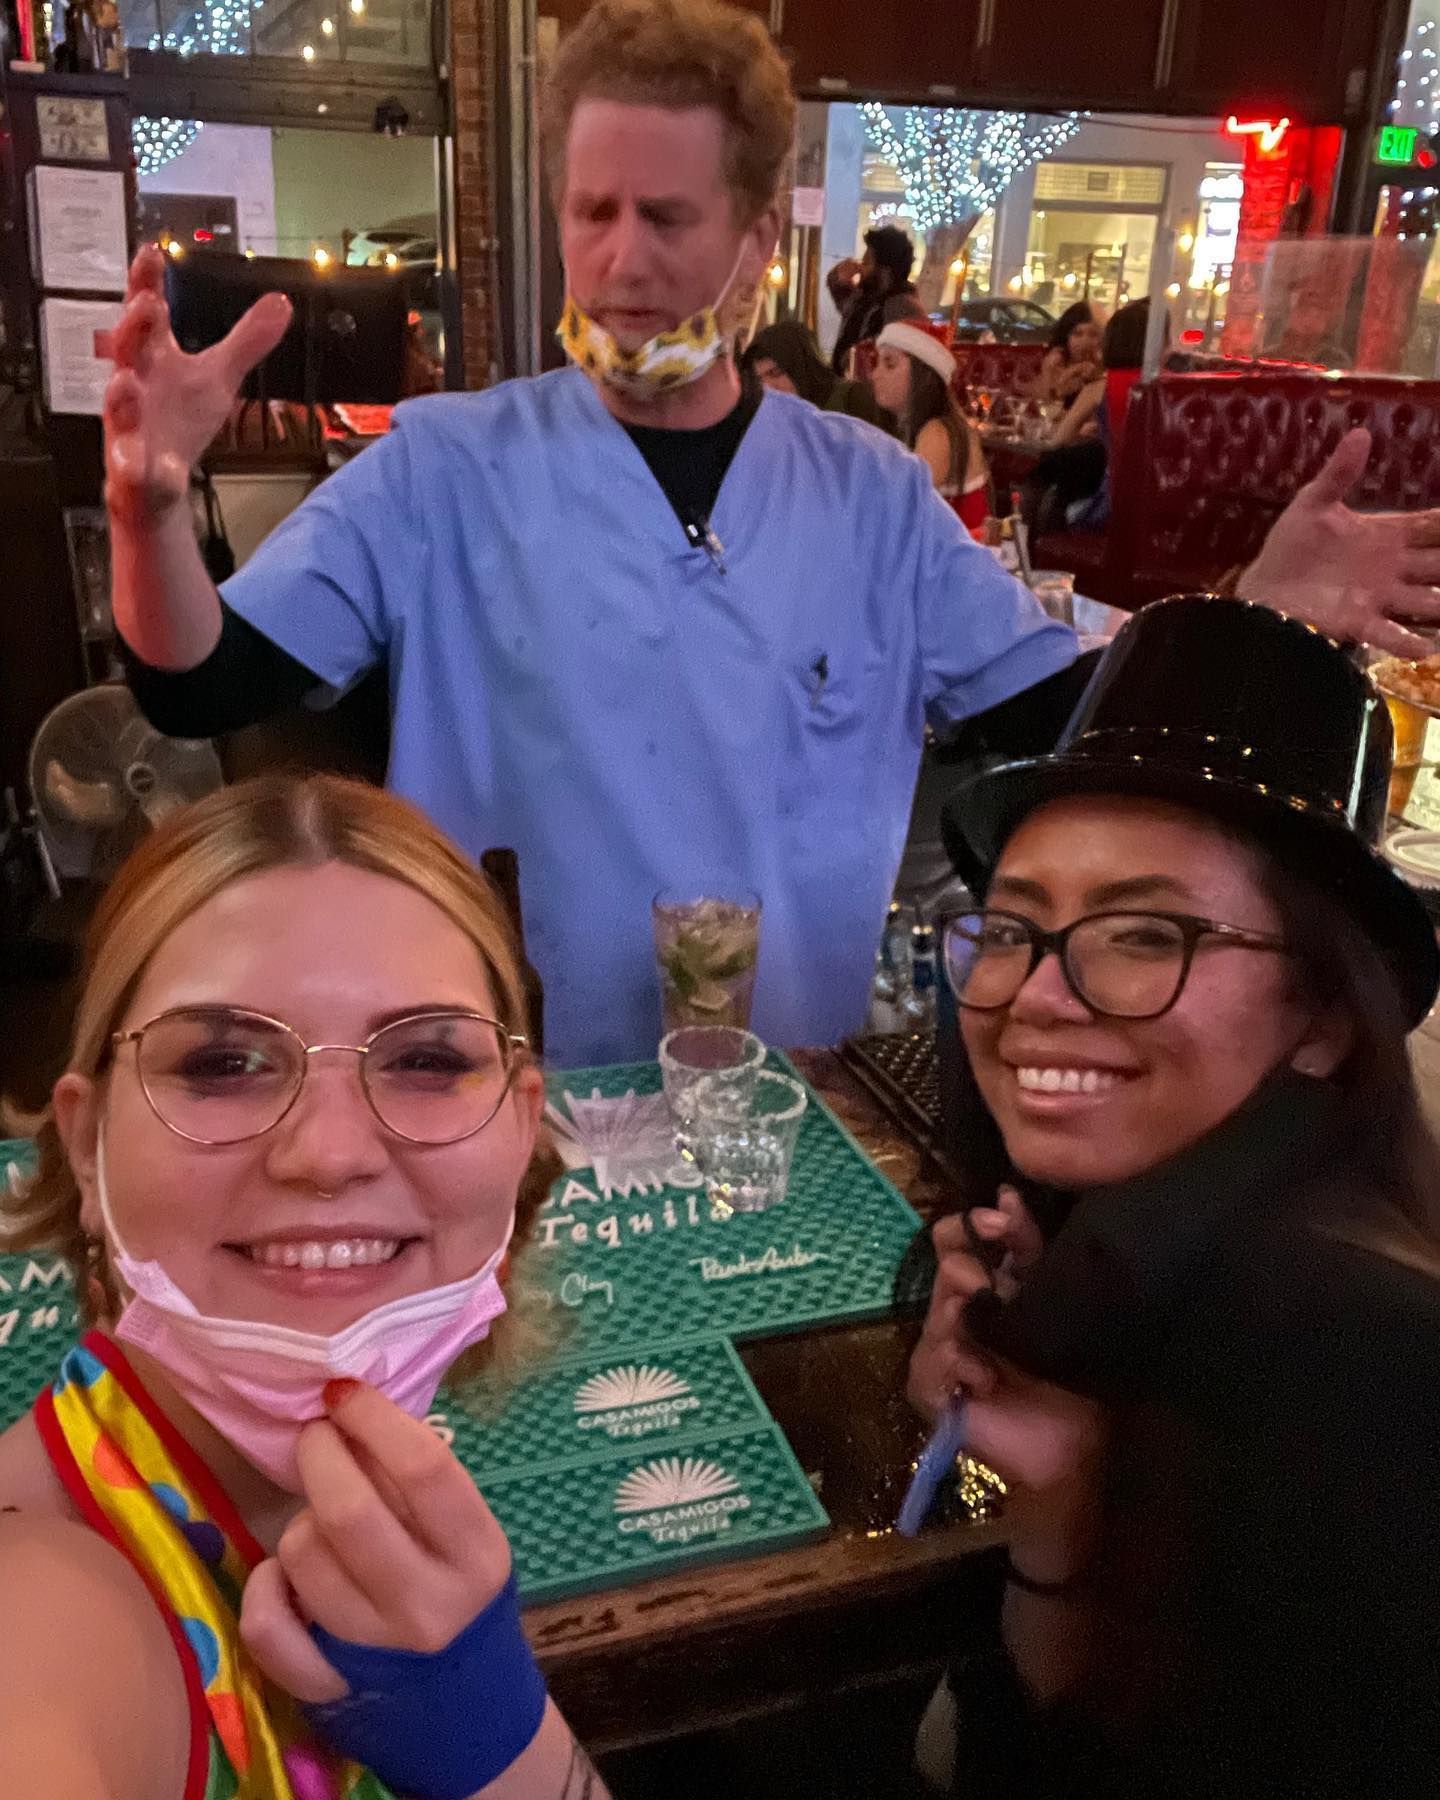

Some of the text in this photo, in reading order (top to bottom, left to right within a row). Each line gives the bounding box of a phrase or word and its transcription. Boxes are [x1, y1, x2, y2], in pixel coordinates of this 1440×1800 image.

[1379, 127, 1418, 162] EXIT
[538, 1194, 734, 1249] Tequila
[576, 1396, 700, 1430] CASAMIGOS
[606, 1416, 681, 1437] Tequila
[617, 1494, 750, 1533] CASAMIGOS
[652, 1516, 730, 1543] Tequila
